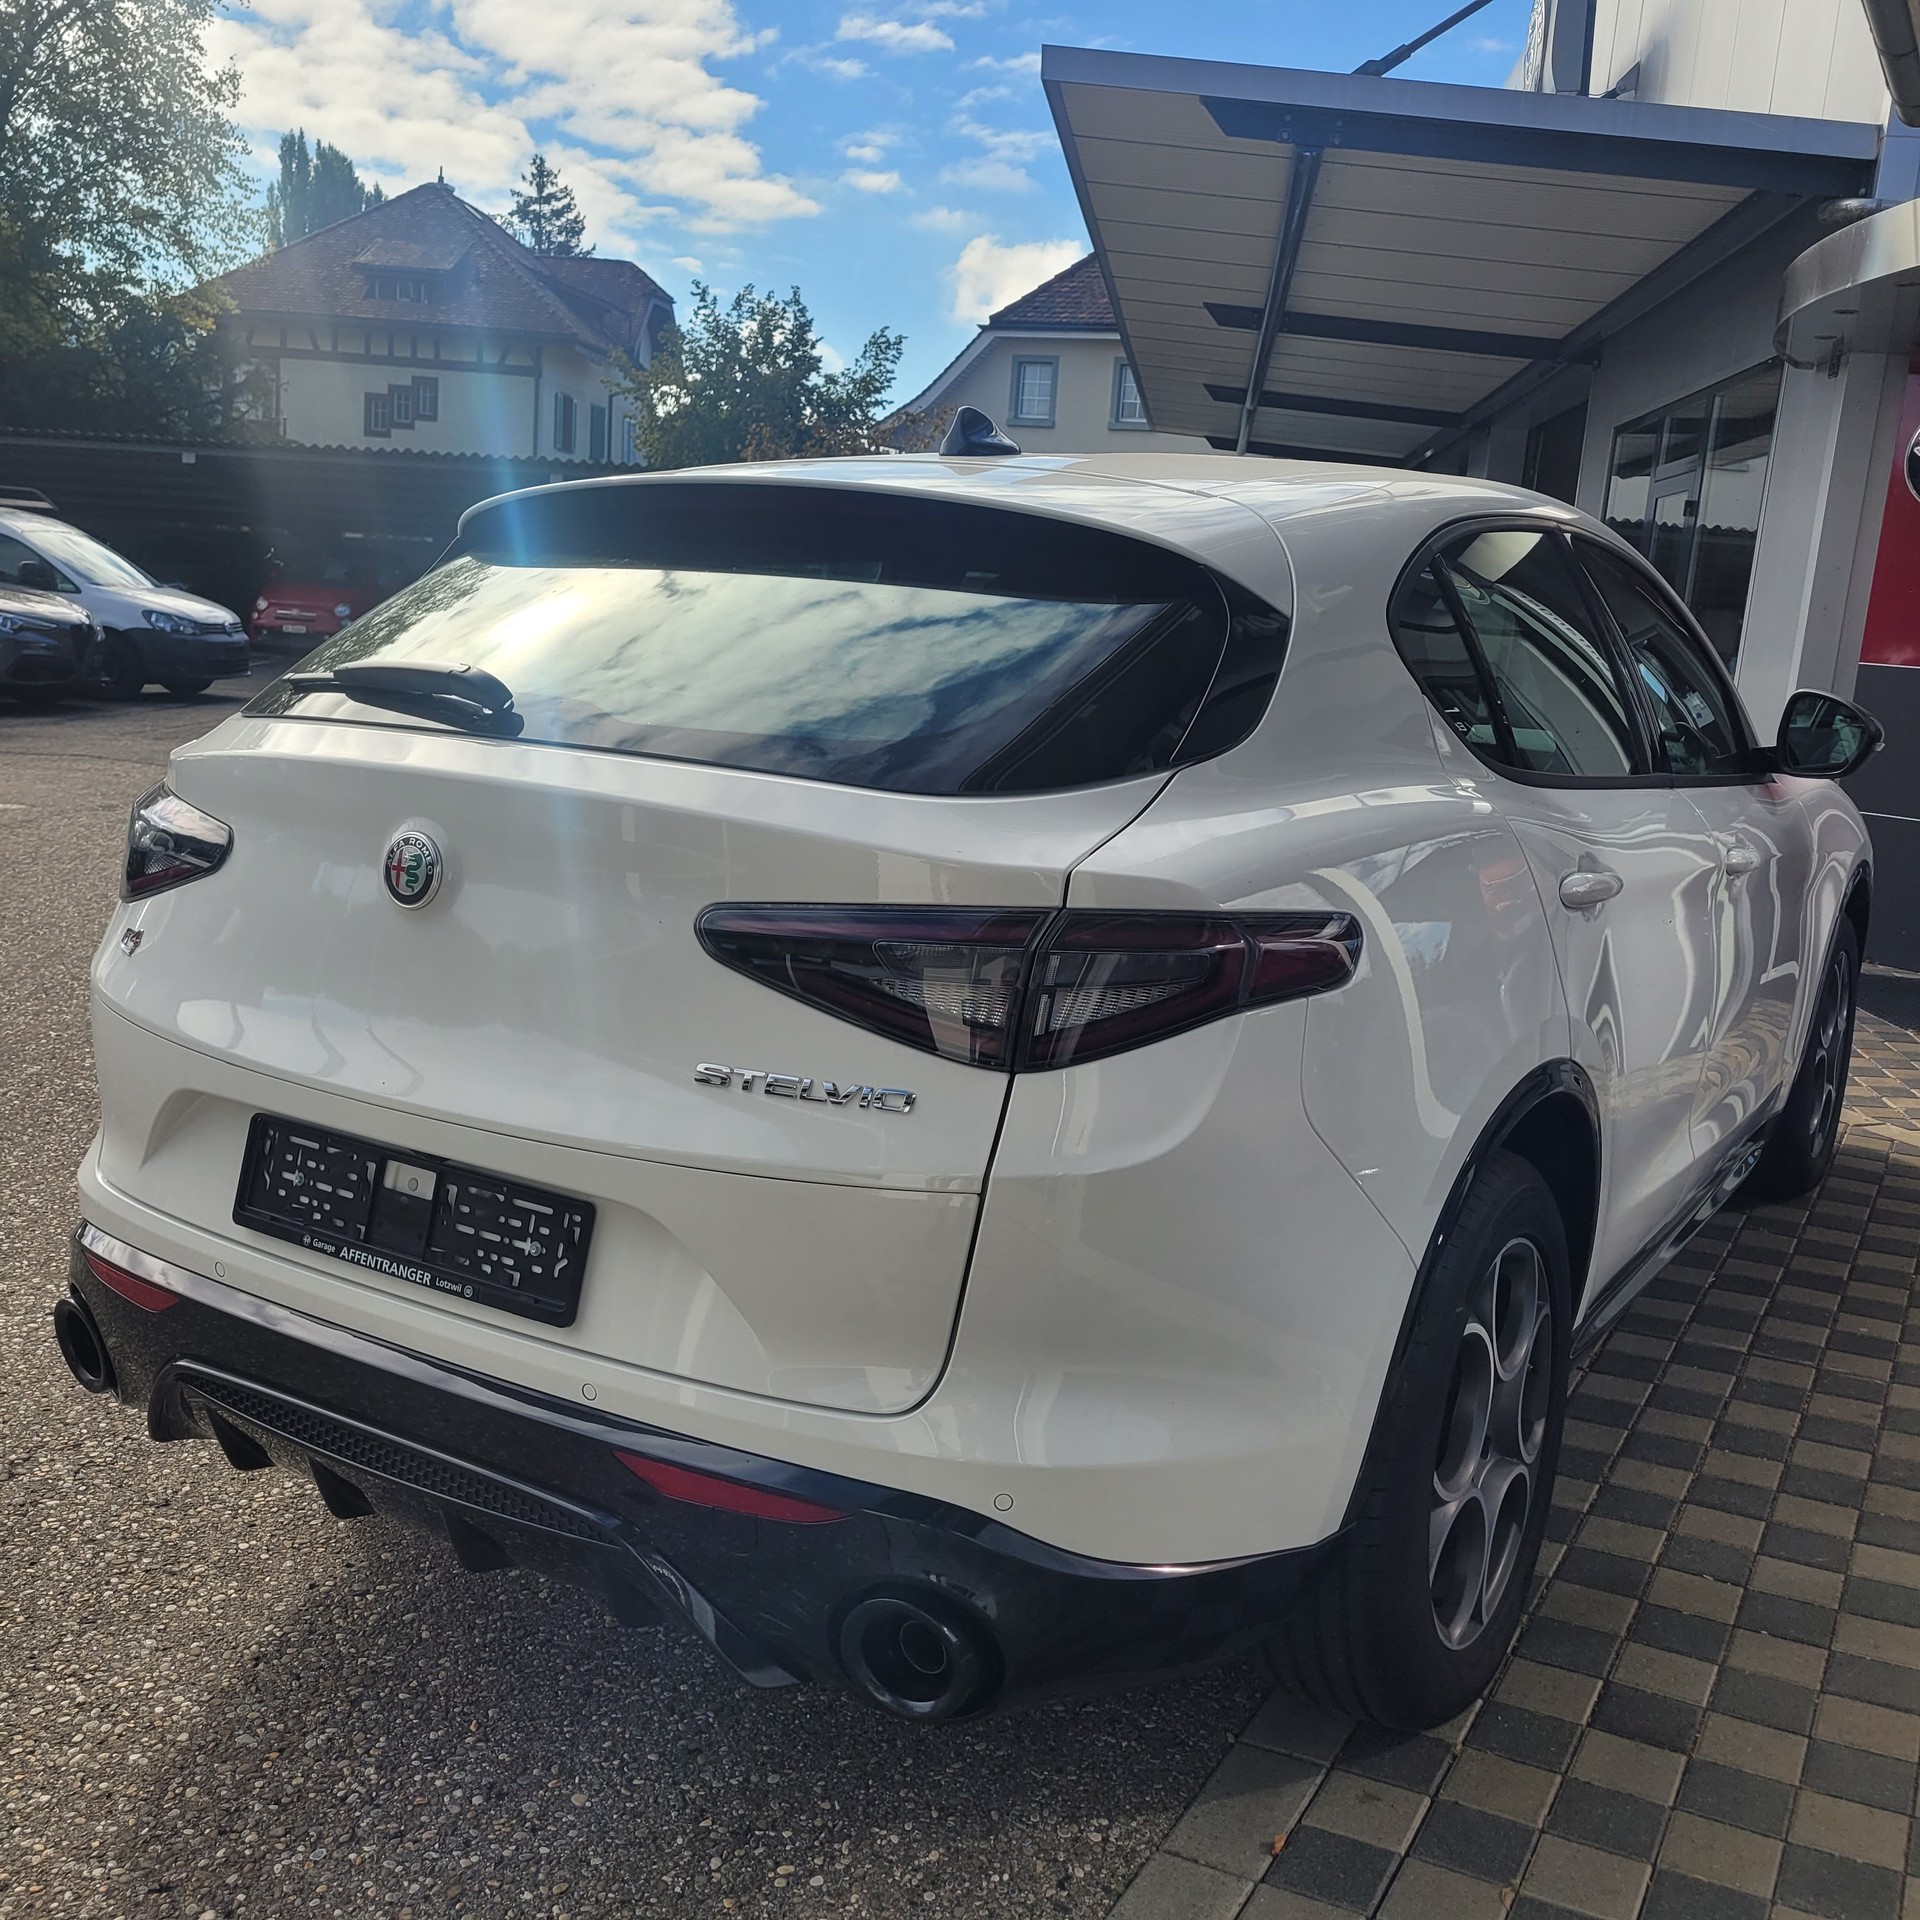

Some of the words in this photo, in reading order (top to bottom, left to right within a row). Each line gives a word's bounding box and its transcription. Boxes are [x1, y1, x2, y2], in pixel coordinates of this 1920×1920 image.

[387, 840, 405, 867] ALFA
[409, 837, 433, 875] ROMEO
[694, 1062, 917, 1114] STELVIO
[312, 1238, 336, 1253] Garage
[339, 1246, 432, 1286] AFFENTRANGER
[435, 1277, 463, 1293] Lotzwil
